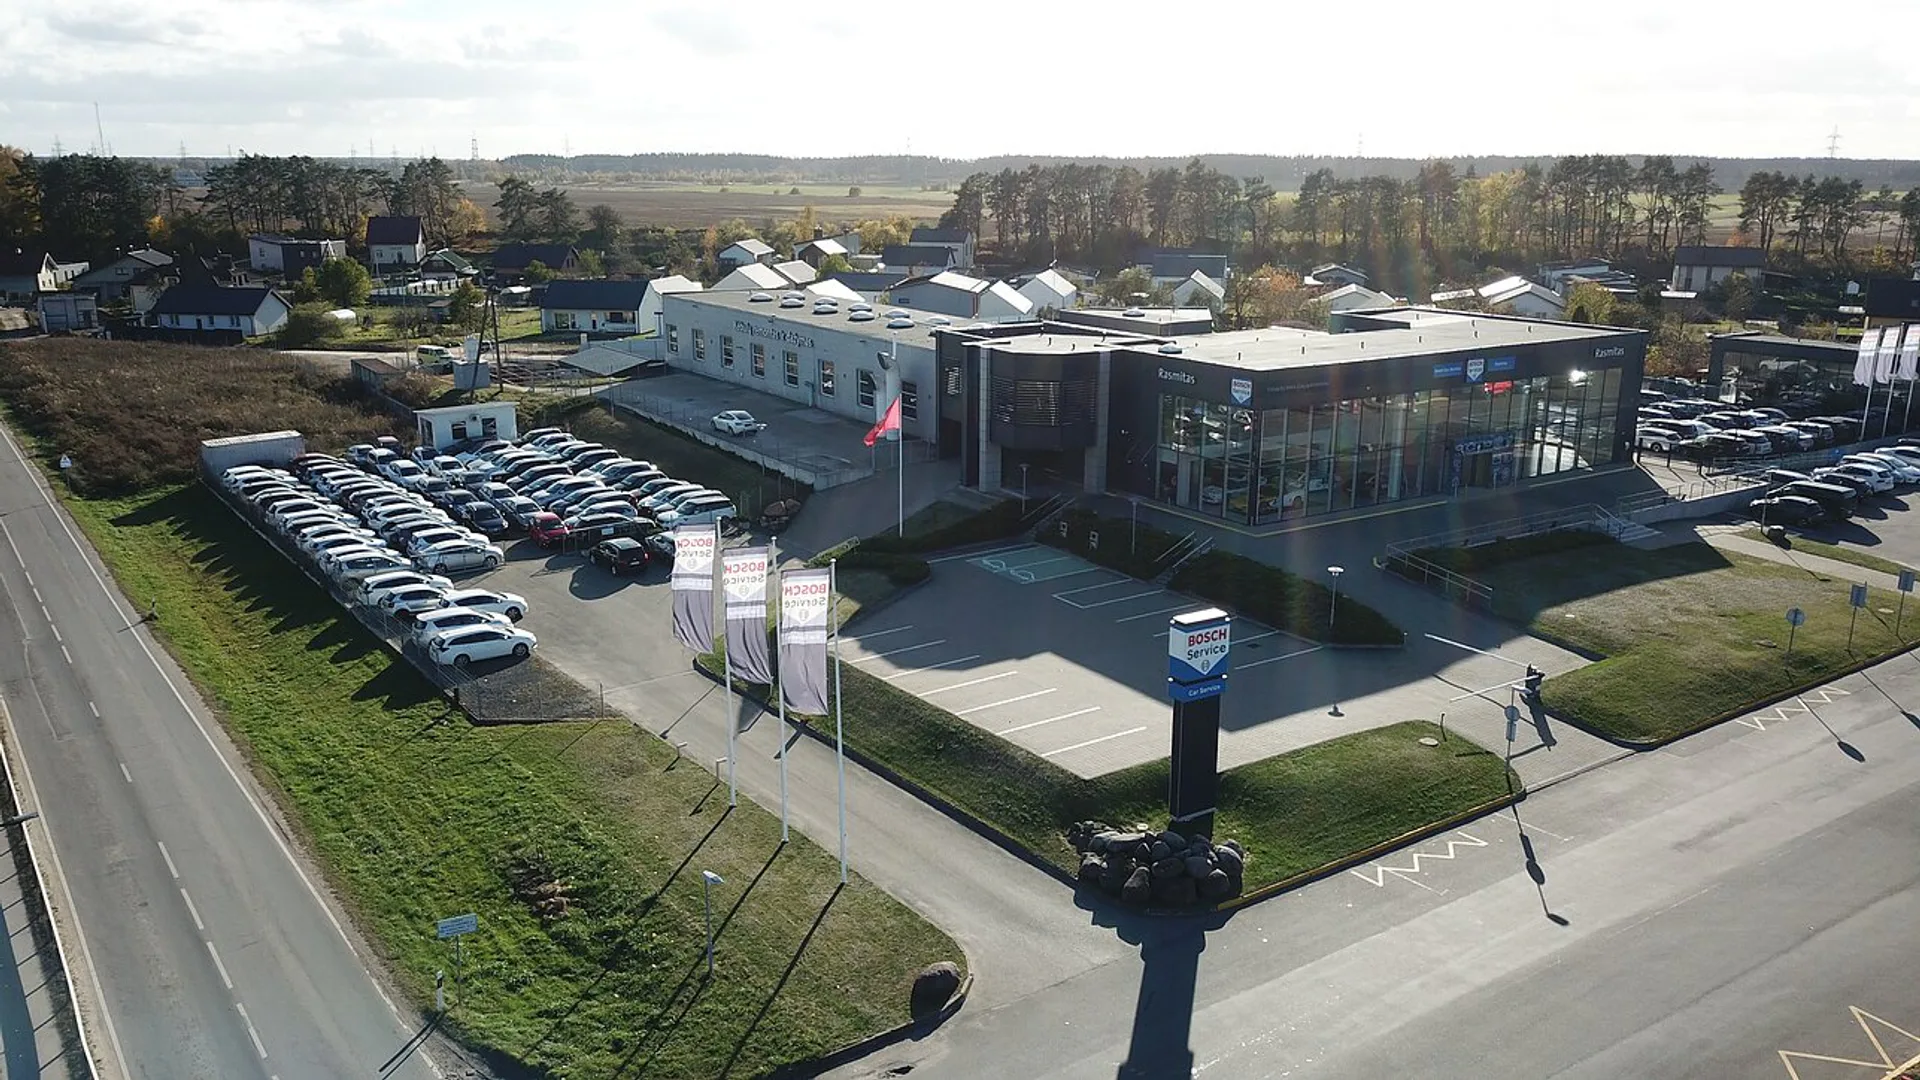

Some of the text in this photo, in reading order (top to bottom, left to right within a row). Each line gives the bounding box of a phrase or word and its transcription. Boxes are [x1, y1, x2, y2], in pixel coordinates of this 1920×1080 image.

[1158, 367, 1195, 385] Rasmitas
[1188, 629, 1227, 647] BOSCH
[1187, 644, 1226, 660] Service
[1188, 684, 1221, 697] Car Service
